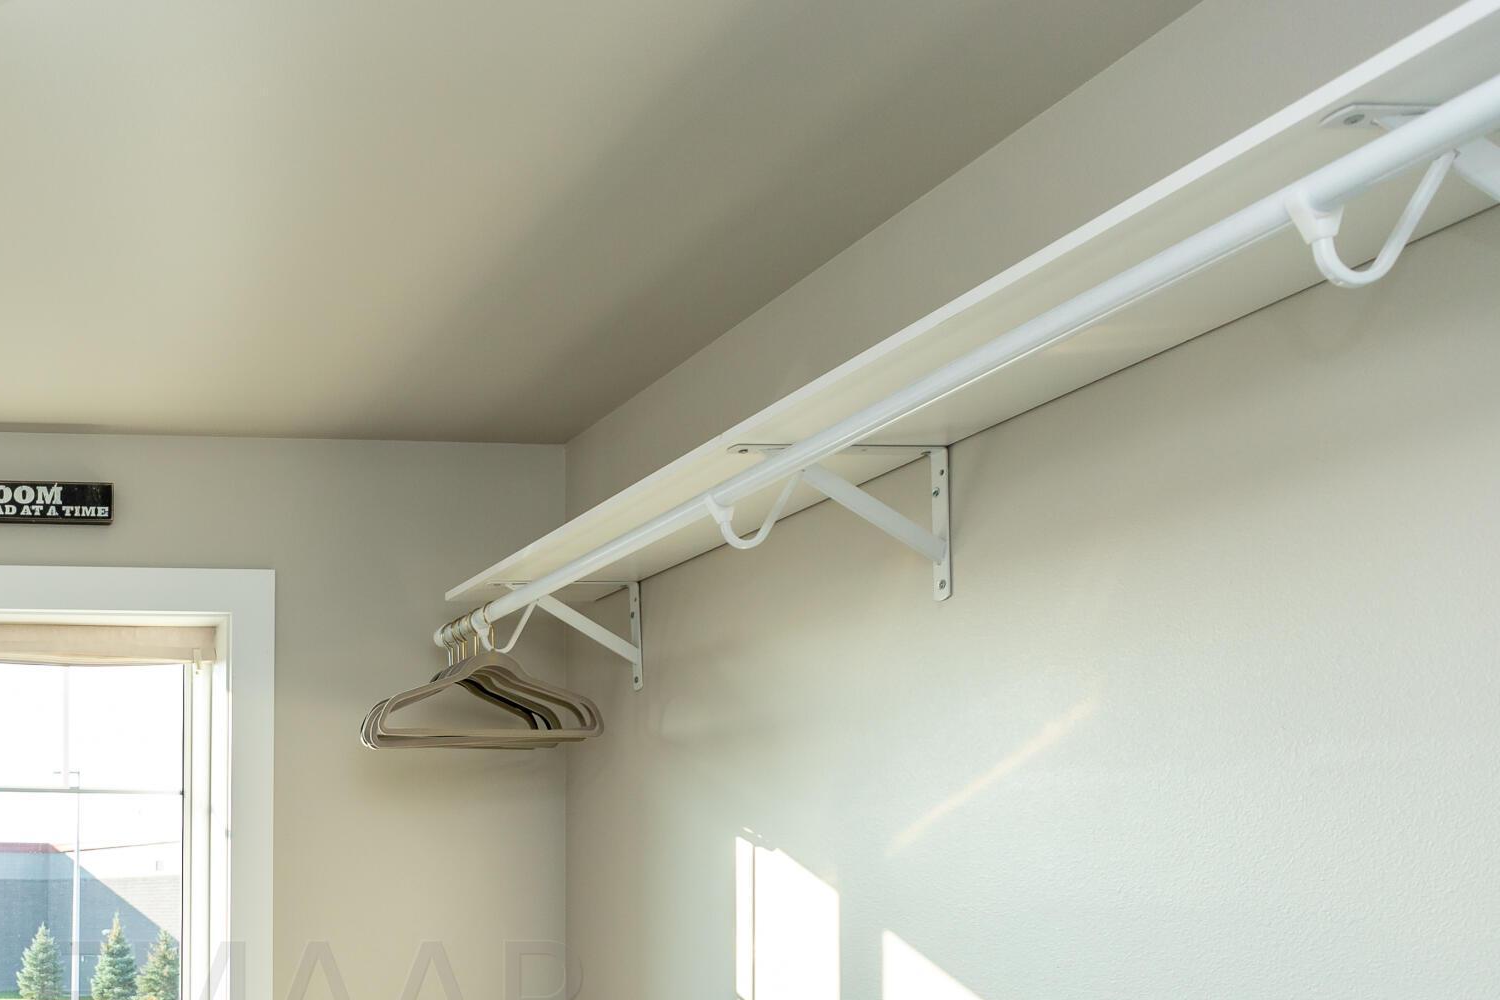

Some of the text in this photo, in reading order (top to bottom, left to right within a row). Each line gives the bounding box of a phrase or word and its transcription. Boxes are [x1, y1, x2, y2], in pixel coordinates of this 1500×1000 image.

[20, 505, 44, 516] AT
[46, 505, 58, 516] A
[62, 506, 109, 517] TIME
